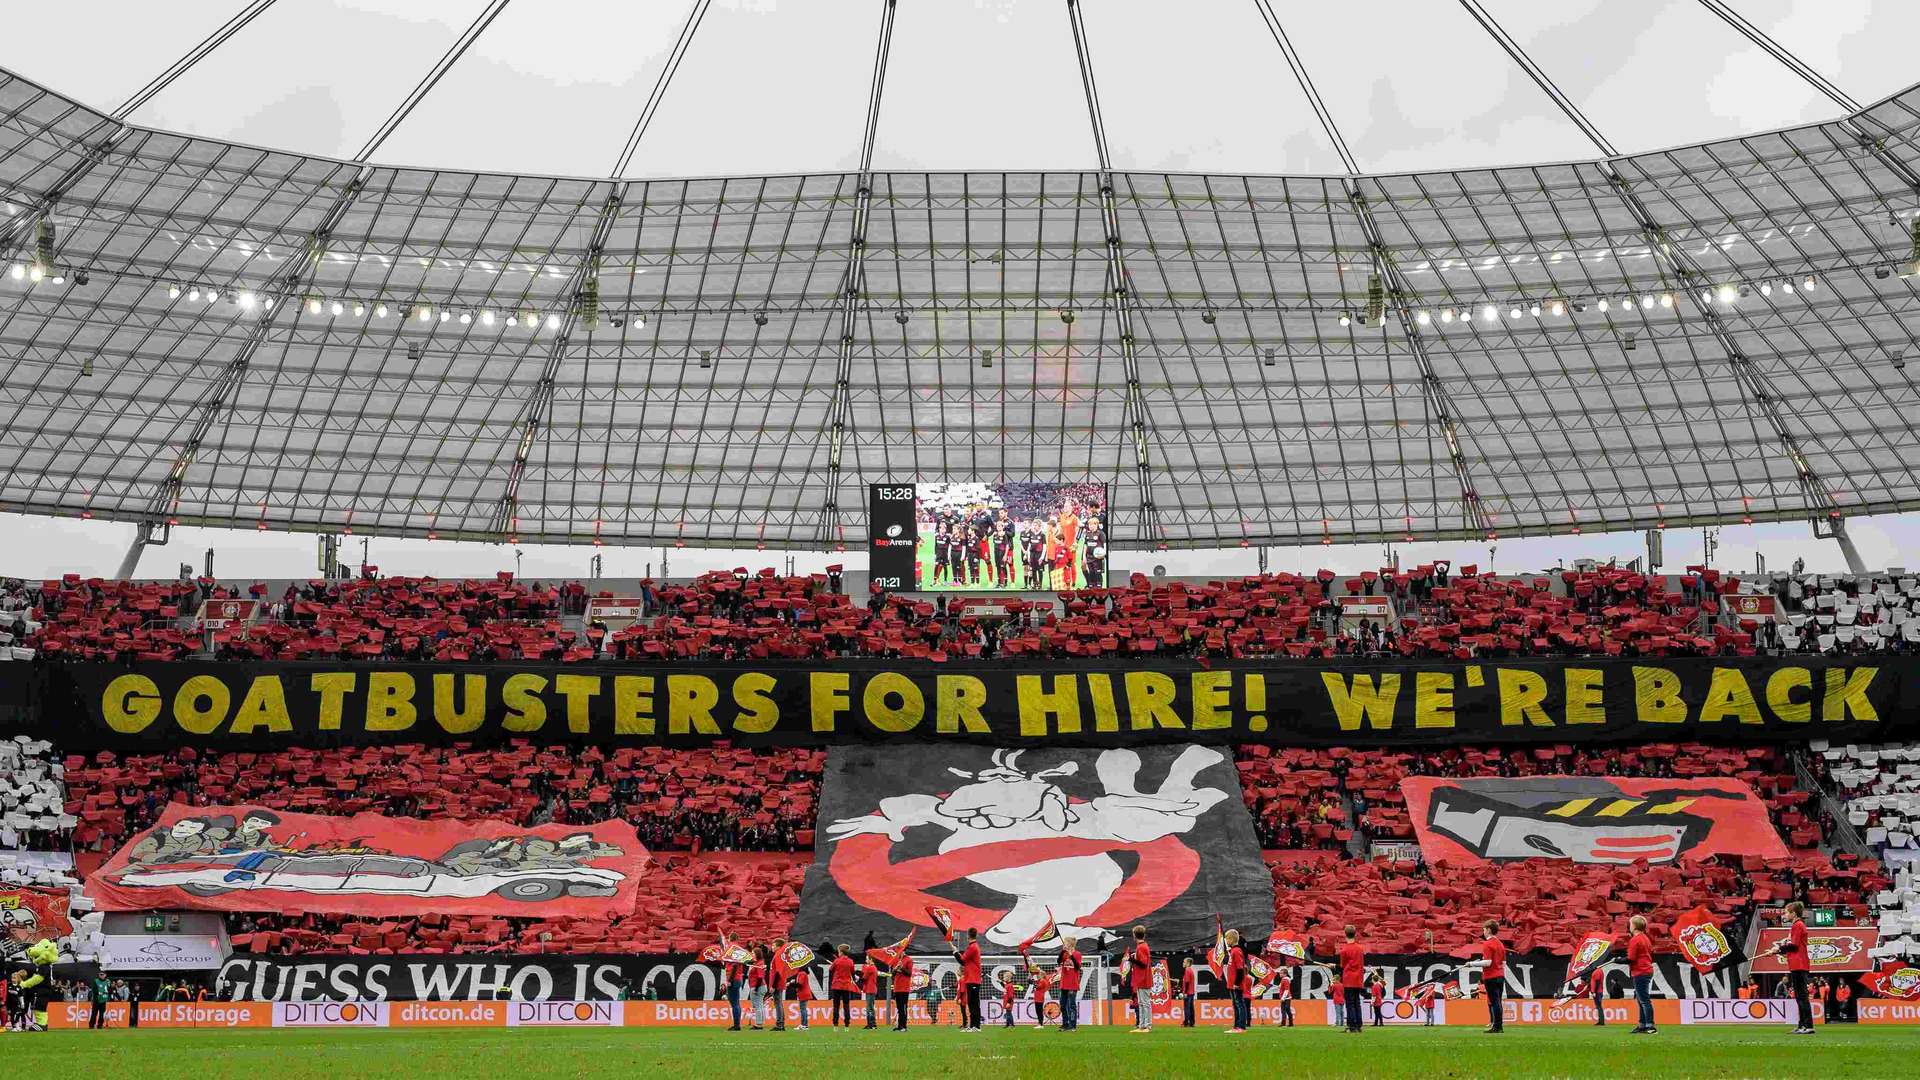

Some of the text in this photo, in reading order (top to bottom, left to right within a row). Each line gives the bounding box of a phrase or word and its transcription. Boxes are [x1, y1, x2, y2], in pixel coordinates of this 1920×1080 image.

[877, 487, 913, 500] 15:28
[102, 665, 1880, 736] GOATBUSTERS FOR HIRE! WE'RE BACK
[215, 959, 391, 1001] GUESS
[407, 963, 553, 1001] WHO
[573, 963, 622, 1001] IS
[139, 1003, 171, 1022] und
[175, 1005, 251, 1026] Storage
[285, 1003, 377, 1021] DITCON
[401, 1003, 496, 1021] ditcon.de
[519, 1003, 611, 1021] DITCON
[1201, 1003, 1296, 1023] Excang
[1692, 1001, 1786, 1019] DITCON
